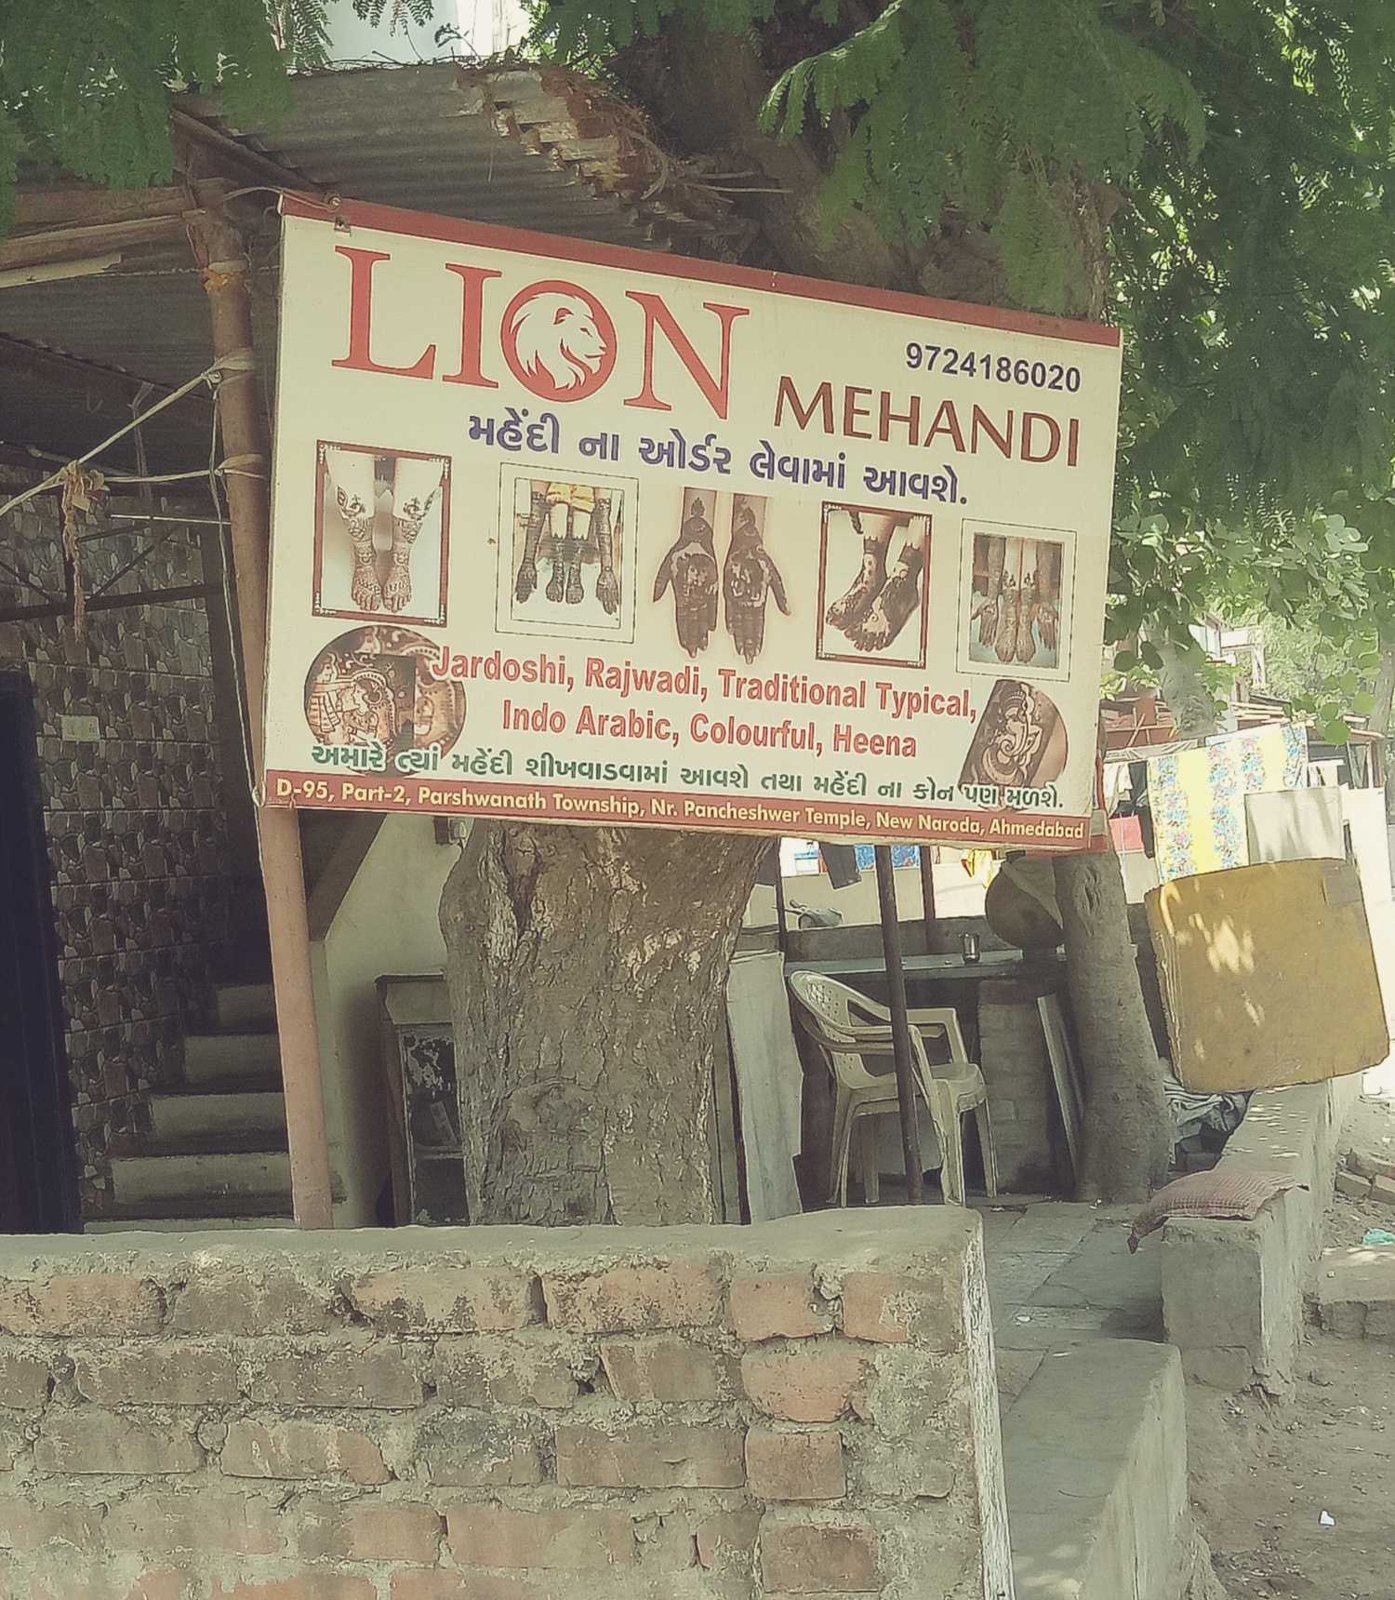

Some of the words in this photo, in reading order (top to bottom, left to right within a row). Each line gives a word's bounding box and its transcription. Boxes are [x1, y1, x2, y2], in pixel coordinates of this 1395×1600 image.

[331, 245, 750, 420] LION
[774, 376, 1079, 467] MEHANDI
[906, 343, 1082, 393] 9724186020
[469, 406, 560, 454] મહેંદી
[579, 432, 619, 461] ના
[639, 429, 732, 476] ઓર્ડર
[749, 440, 845, 490] લેવામાં
[863, 465, 967, 505] આવશે.
[432, 646, 574, 692] Jardoshi,
[585, 657, 708, 703] Rajwadi,
[718, 668, 866, 708] Traditional
[875, 681, 977, 723] Typical,
[503, 699, 566, 733] Indo
[575, 705, 680, 748] Arabic,
[690, 713, 822, 757] Colourful,
[833, 723, 917, 758] Heena
[276, 778, 335, 802] D-95,
[342, 782, 411, 806] Part-2,
[418, 787, 547, 810] Parshwanath
[553, 793, 646, 818] Township,
[651, 799, 677, 816] Nr.
[684, 801, 800, 823] Pancheshwer
[805, 807, 871, 830] Temple,
[876, 812, 912, 829] New
[918, 814, 985, 836] Naroda,
[989, 819, 1084, 839] Ahmedabad
[311, 742, 384, 769] અમારે
[398, 746, 438, 771] ત્યાં
[452, 747, 513, 775] મહેંદી
[525, 752, 668, 784] શીખવાડવામાં
[680, 764, 749, 789] આવશે
[761, 774, 801, 792] તથા
[813, 770, 867, 797] મહેંદી
[877, 781, 902, 799] ના
[913, 776, 954, 802] કોન
[964, 784, 997, 807] પણ
[1007, 785, 1063, 809] મળશે.
